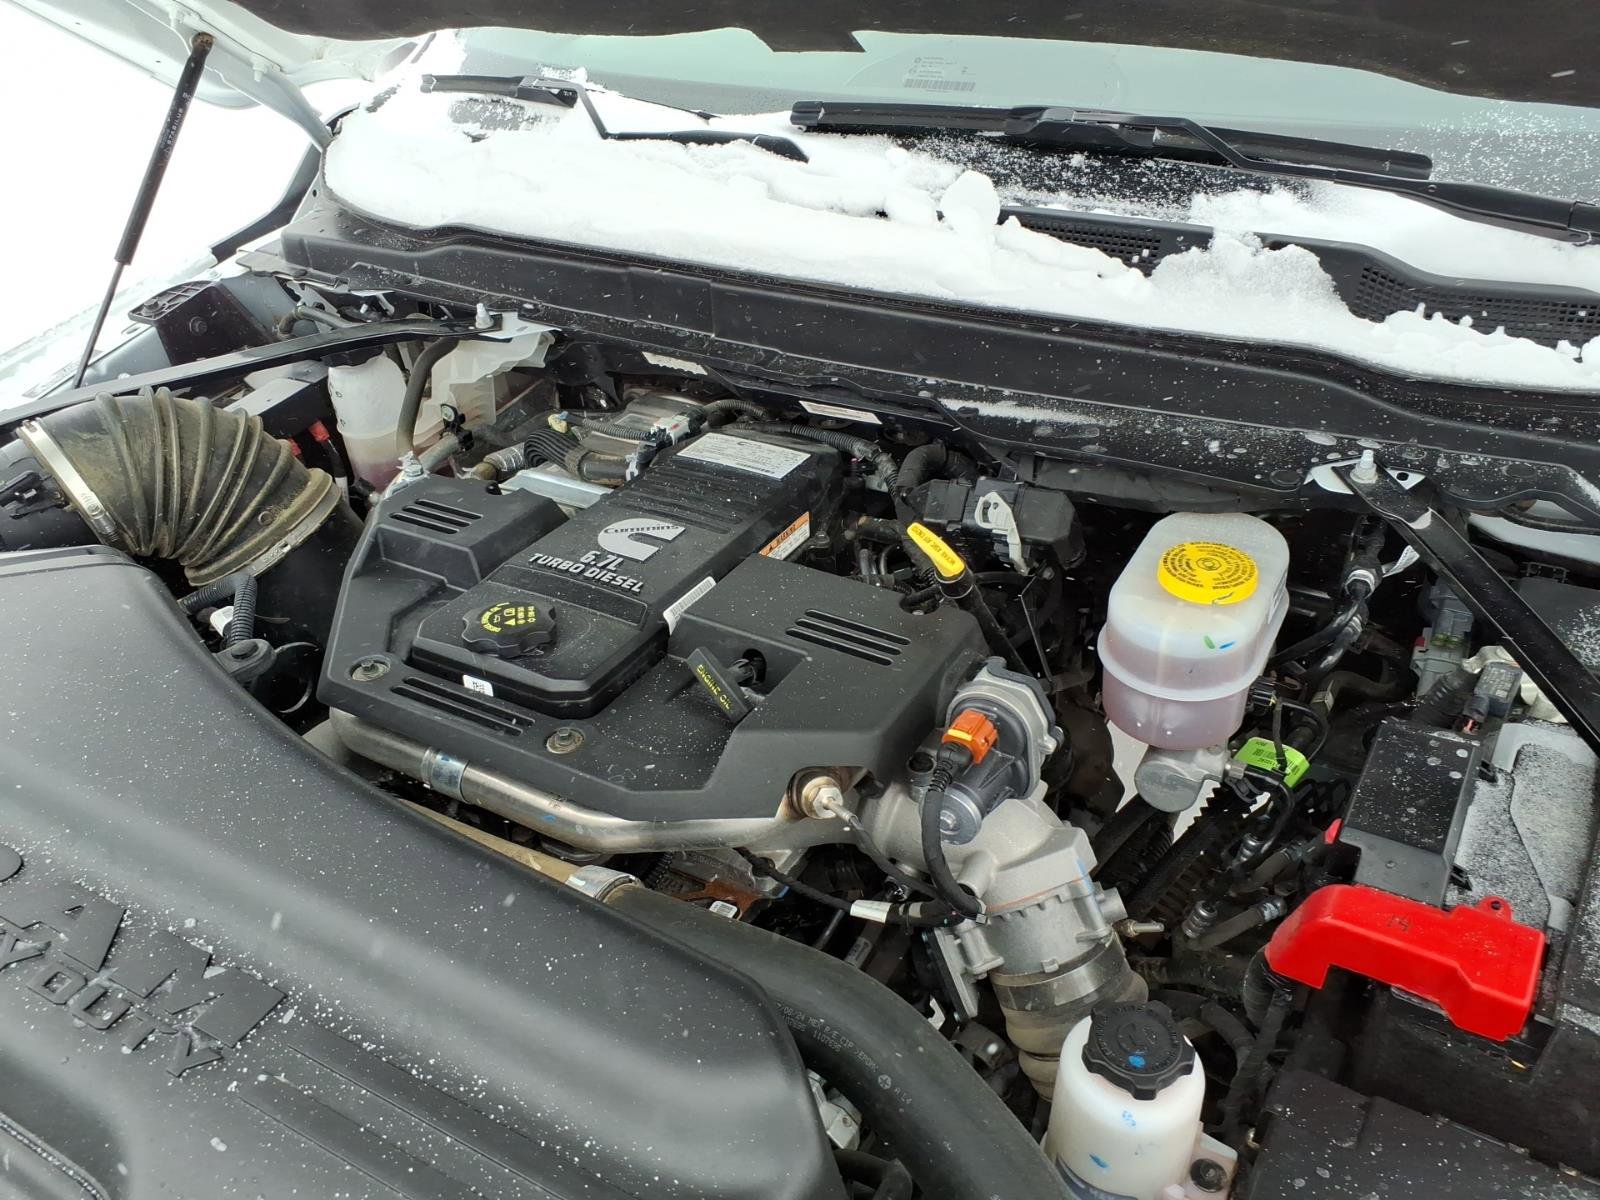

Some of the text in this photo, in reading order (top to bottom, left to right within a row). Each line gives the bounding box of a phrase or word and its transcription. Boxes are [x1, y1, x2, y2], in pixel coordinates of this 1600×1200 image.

[603, 525, 680, 535] Cummins
[528, 552, 586, 574] TURBO
[583, 566, 644, 593] DIESEL
[581, 550, 623, 571] 6.7L
[696, 664, 733, 710] ENGINE OIL
[0, 843, 289, 1049] AM
[25, 961, 225, 1079] DUTY
